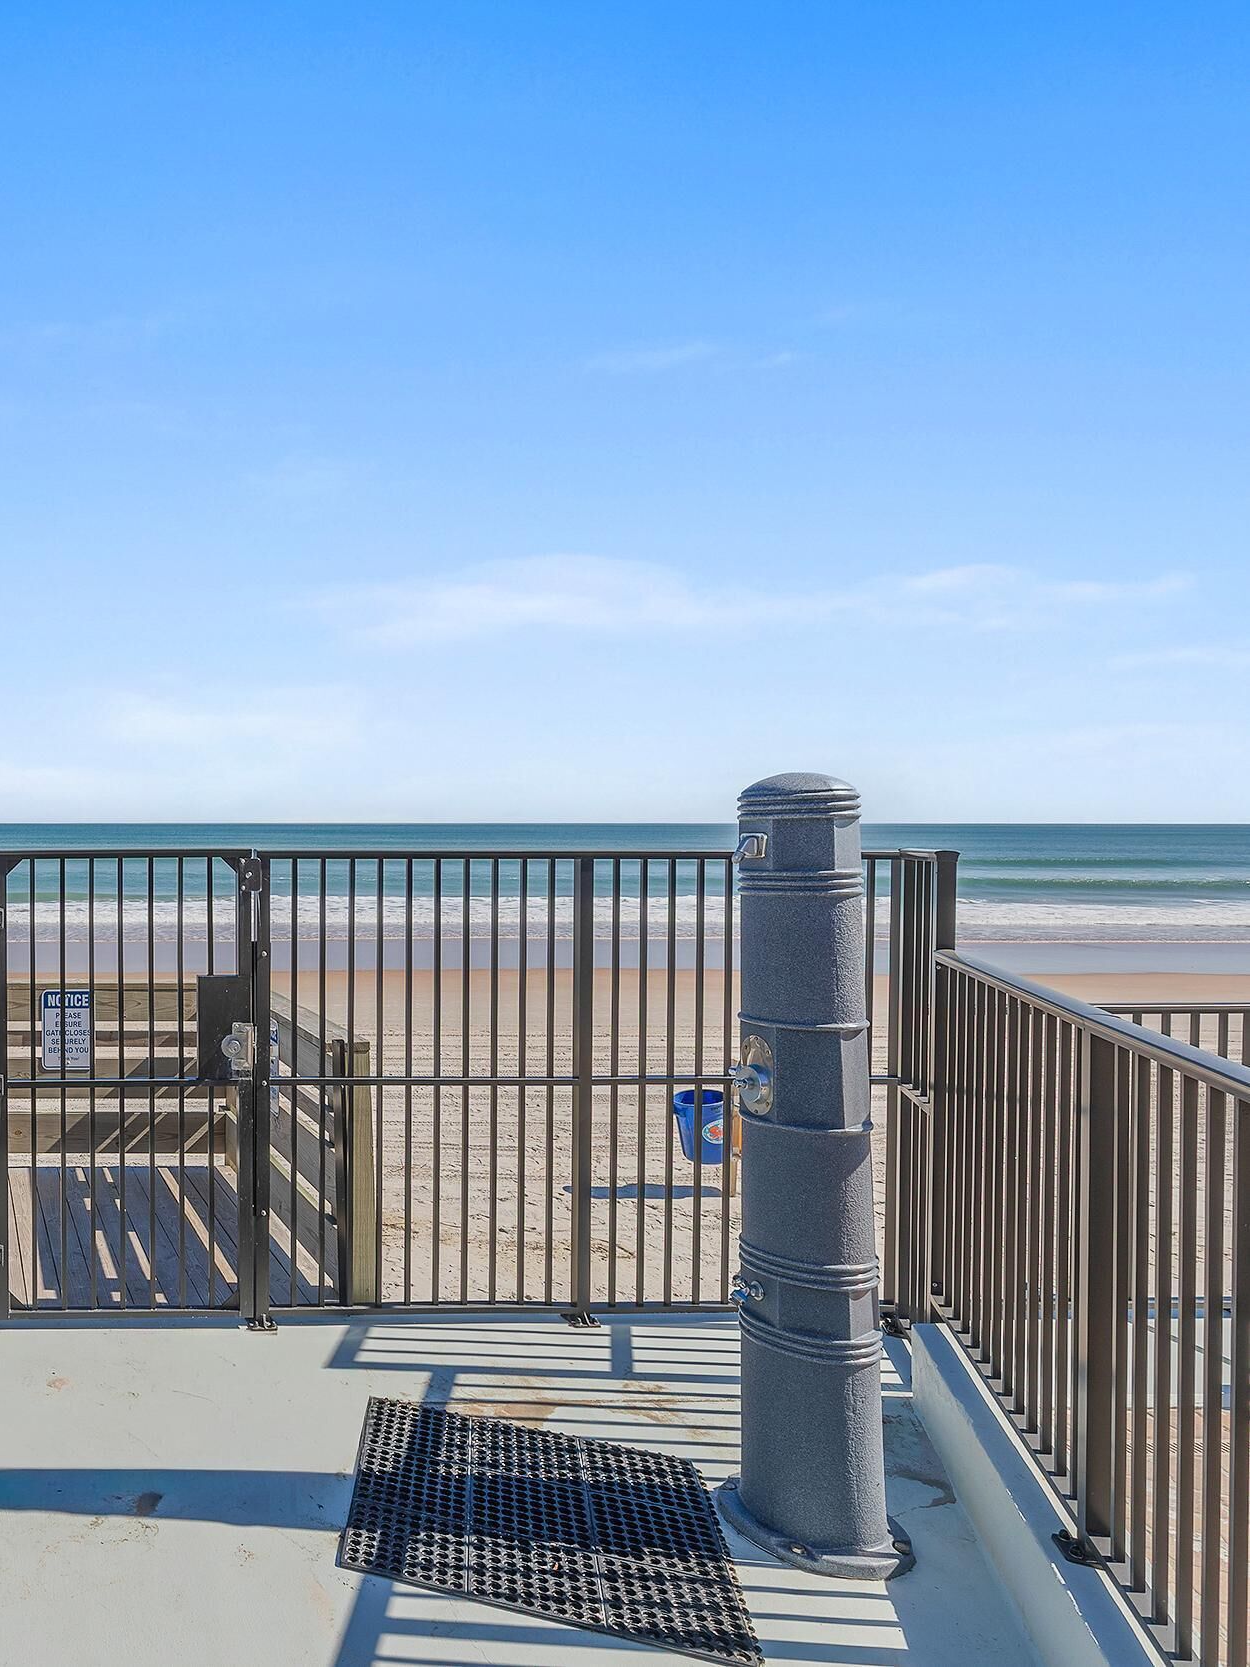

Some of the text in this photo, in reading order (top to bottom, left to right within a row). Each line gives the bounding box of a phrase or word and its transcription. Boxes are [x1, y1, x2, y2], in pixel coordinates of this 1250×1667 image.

[47, 994, 89, 1007] NOTICE
[48, 1046, 89, 1054] BEHND YOU
